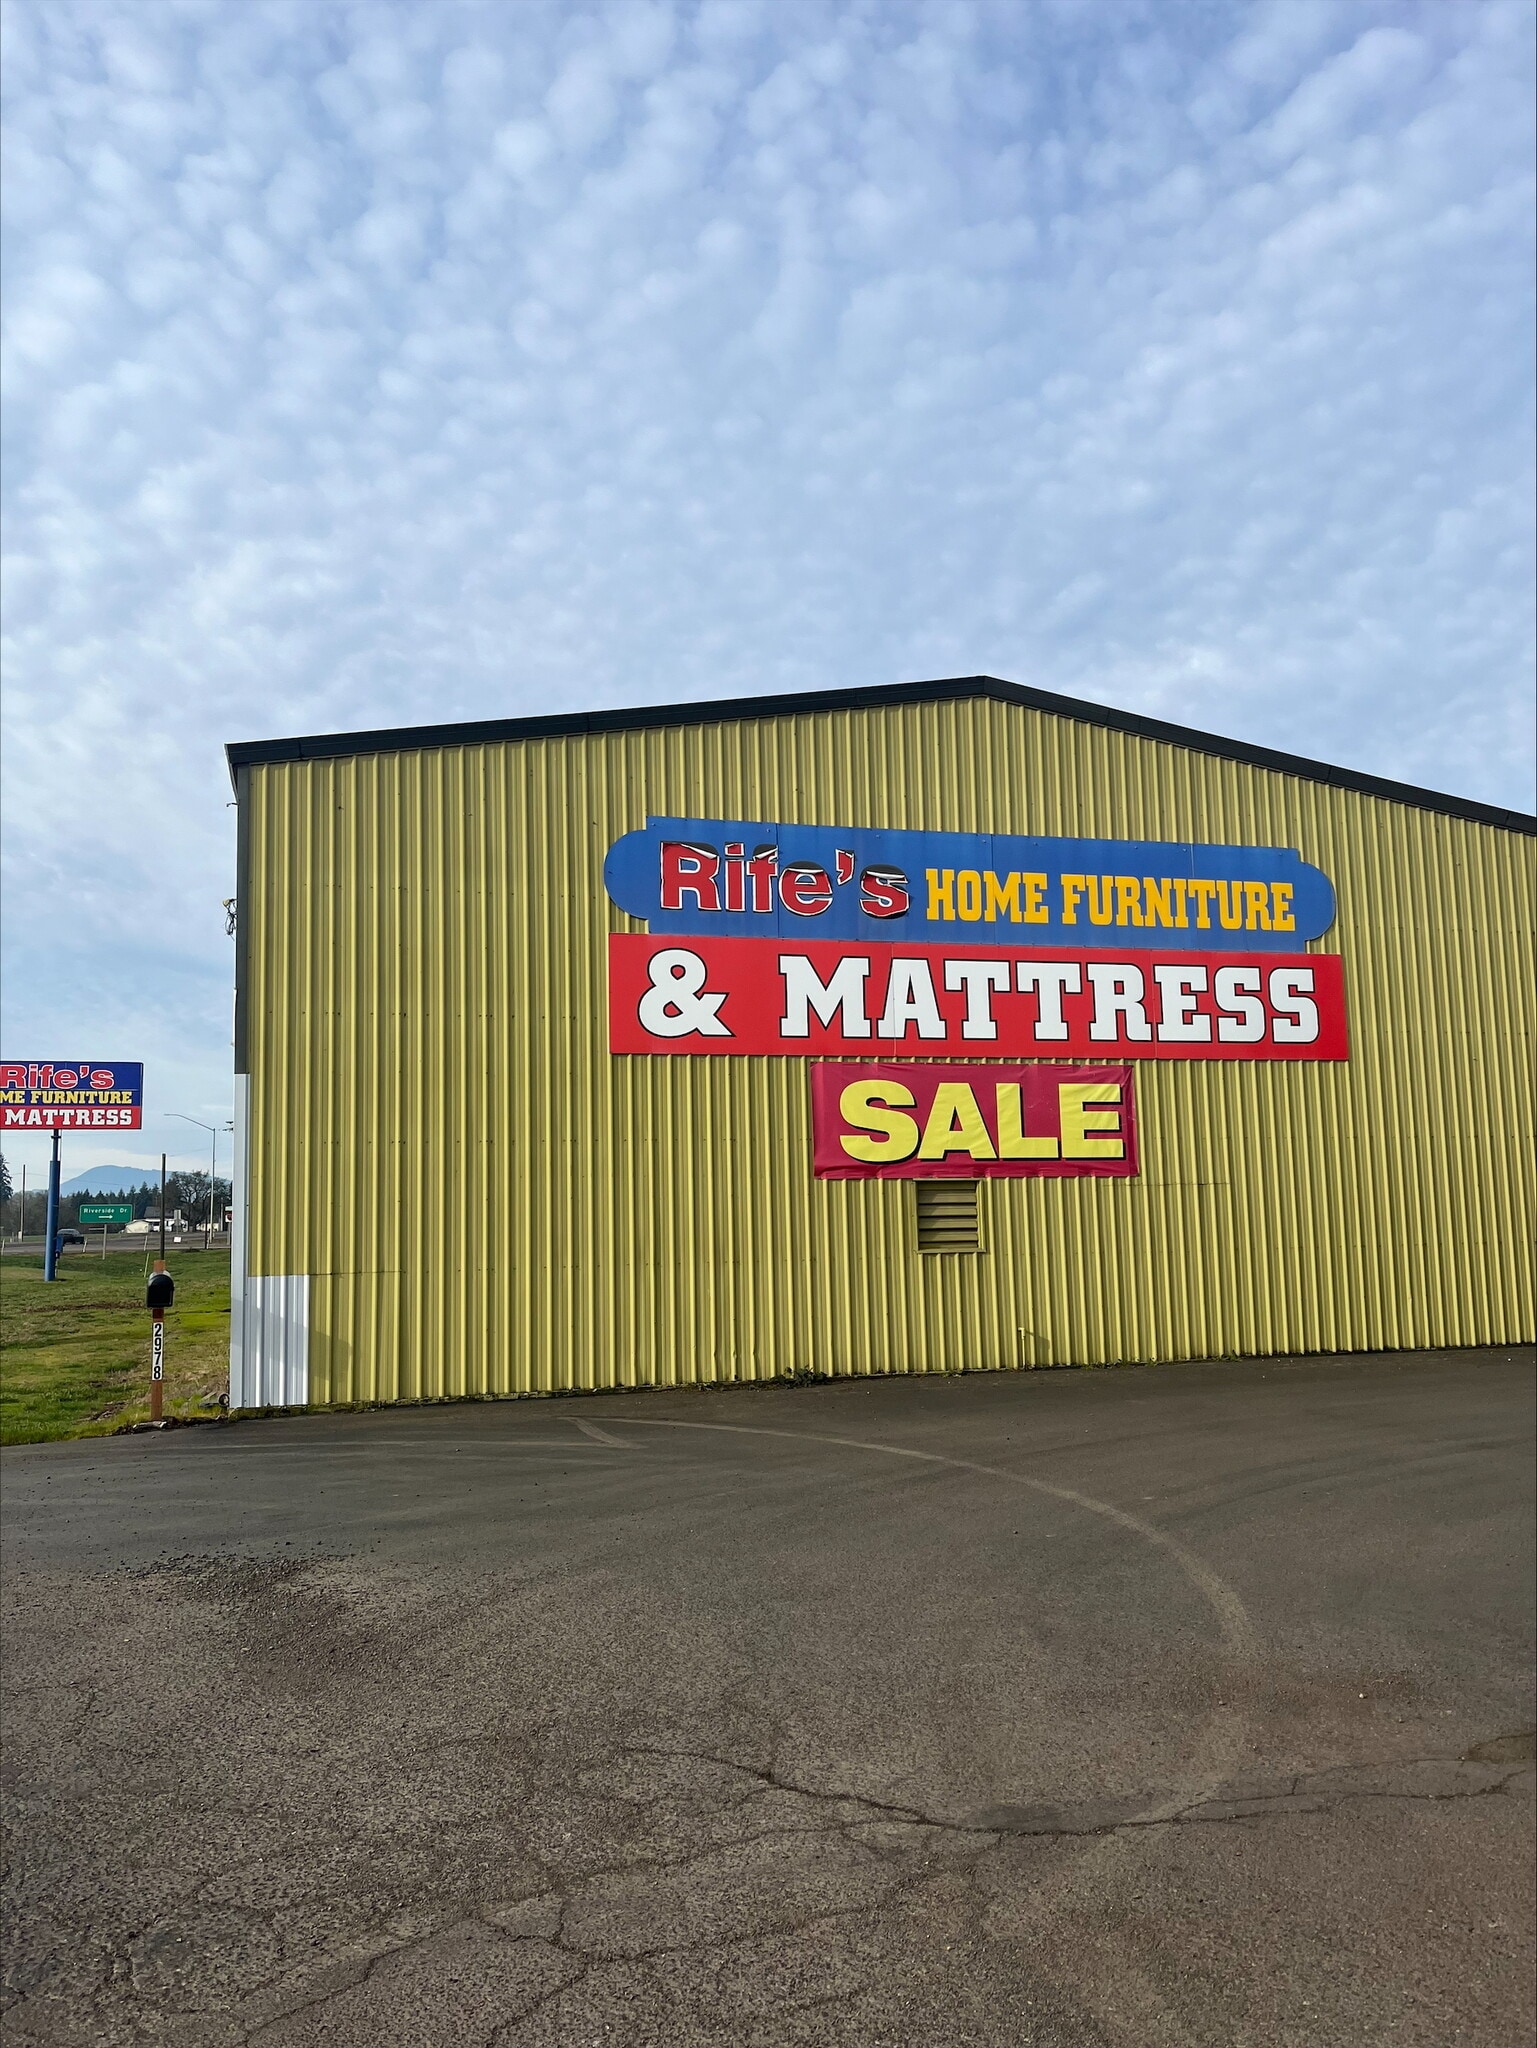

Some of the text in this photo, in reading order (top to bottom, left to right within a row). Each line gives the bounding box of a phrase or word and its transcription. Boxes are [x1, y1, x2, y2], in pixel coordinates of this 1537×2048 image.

[659, 840, 1296, 932] Rife's HOME FURNITURE
[637, 947, 1320, 1044] & MATTRESS
[0, 1064, 115, 1090] Rife's
[30, 1090, 133, 1105] FURNITURE
[4, 1108, 132, 1126] MATTRESS
[839, 1079, 1125, 1165] SALE
[153, 1323, 163, 1380] 2978
